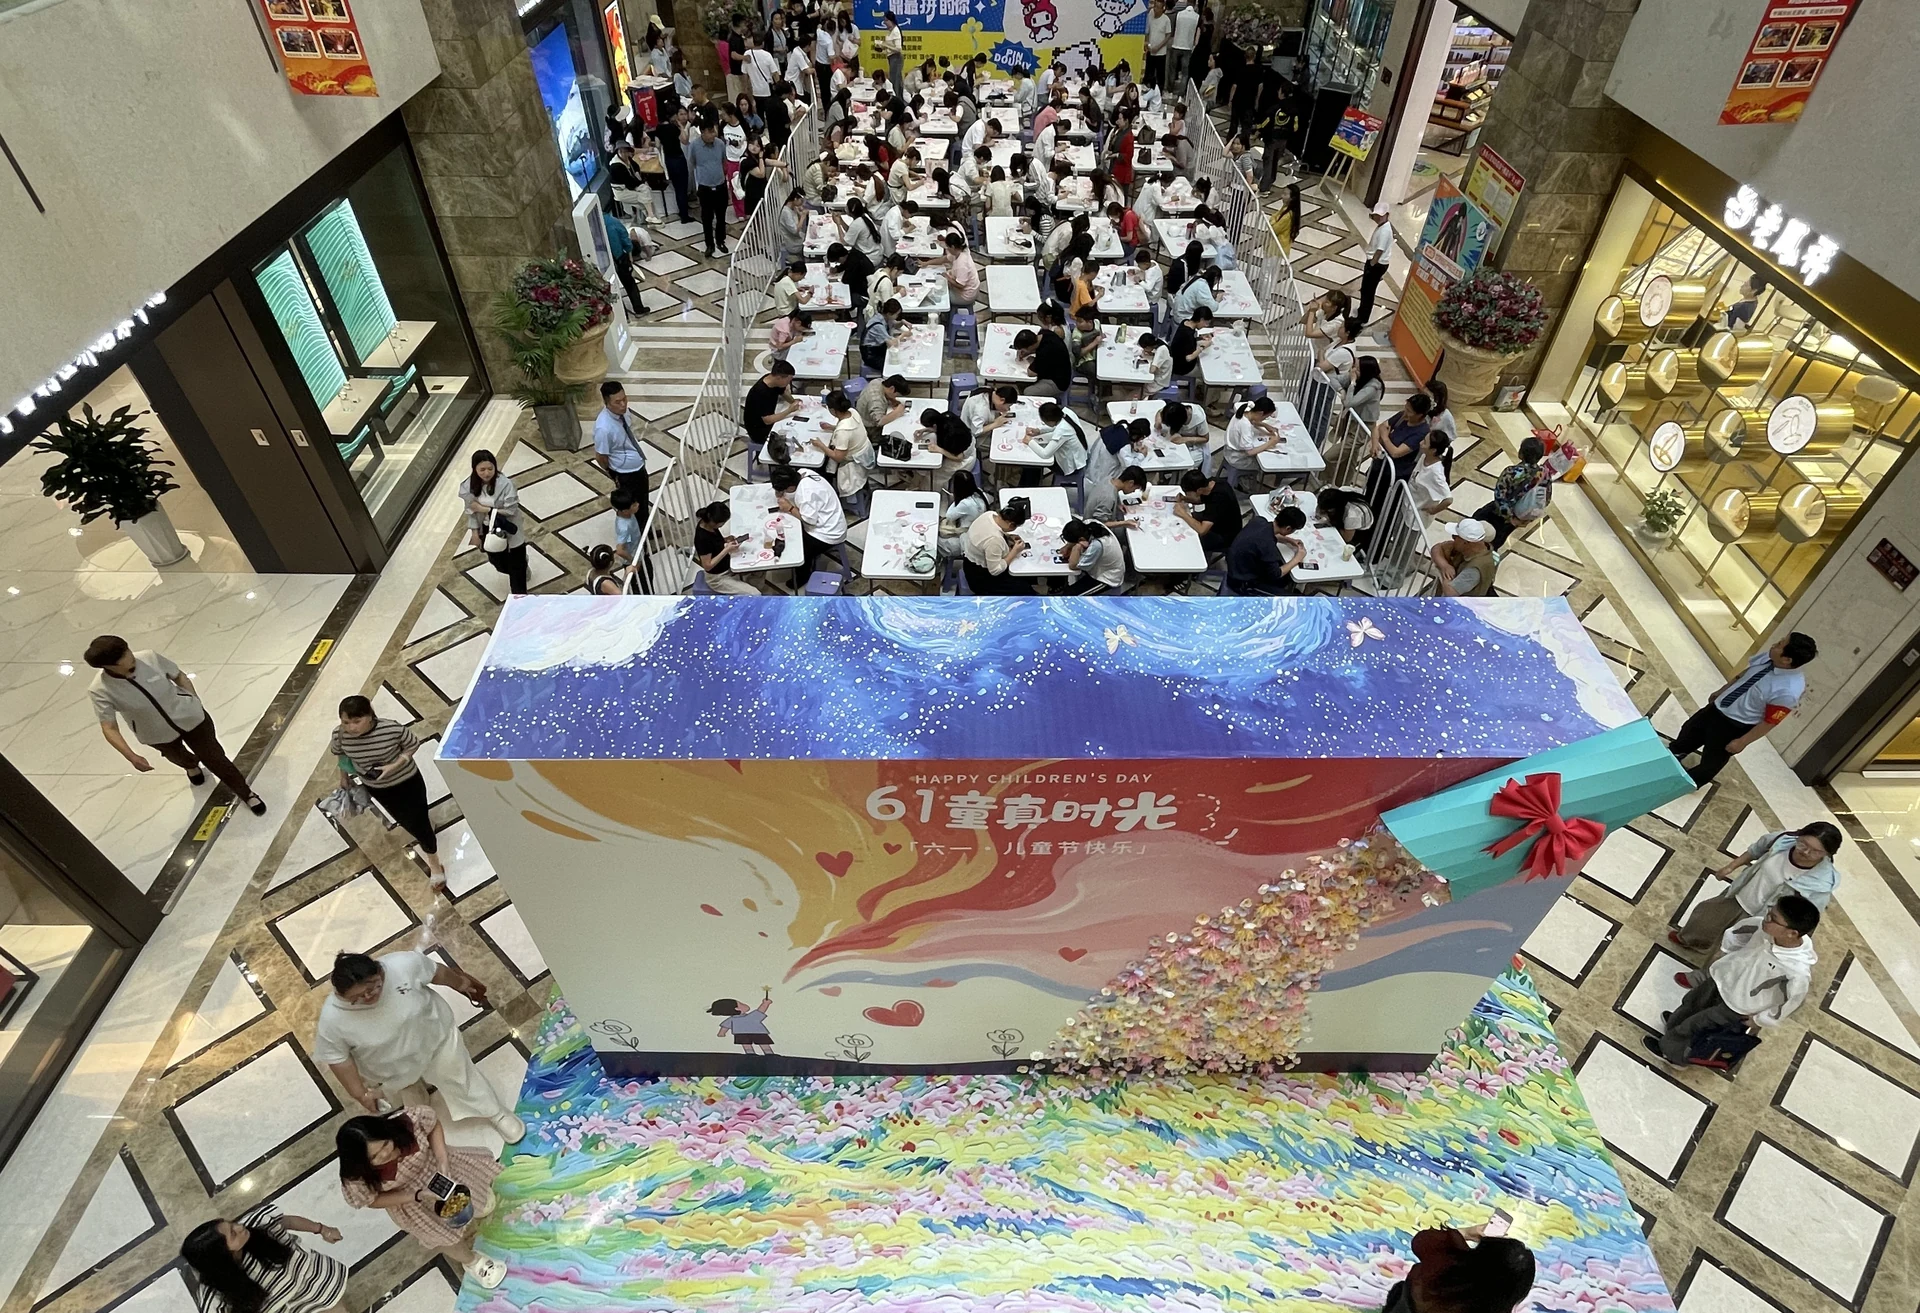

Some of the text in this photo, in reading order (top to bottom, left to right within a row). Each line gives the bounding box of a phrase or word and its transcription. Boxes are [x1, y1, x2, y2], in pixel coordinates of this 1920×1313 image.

[1006, 49, 1023, 61] PIN
[915, 773, 1153, 784] HAPPY CHILDREN'S DAY
